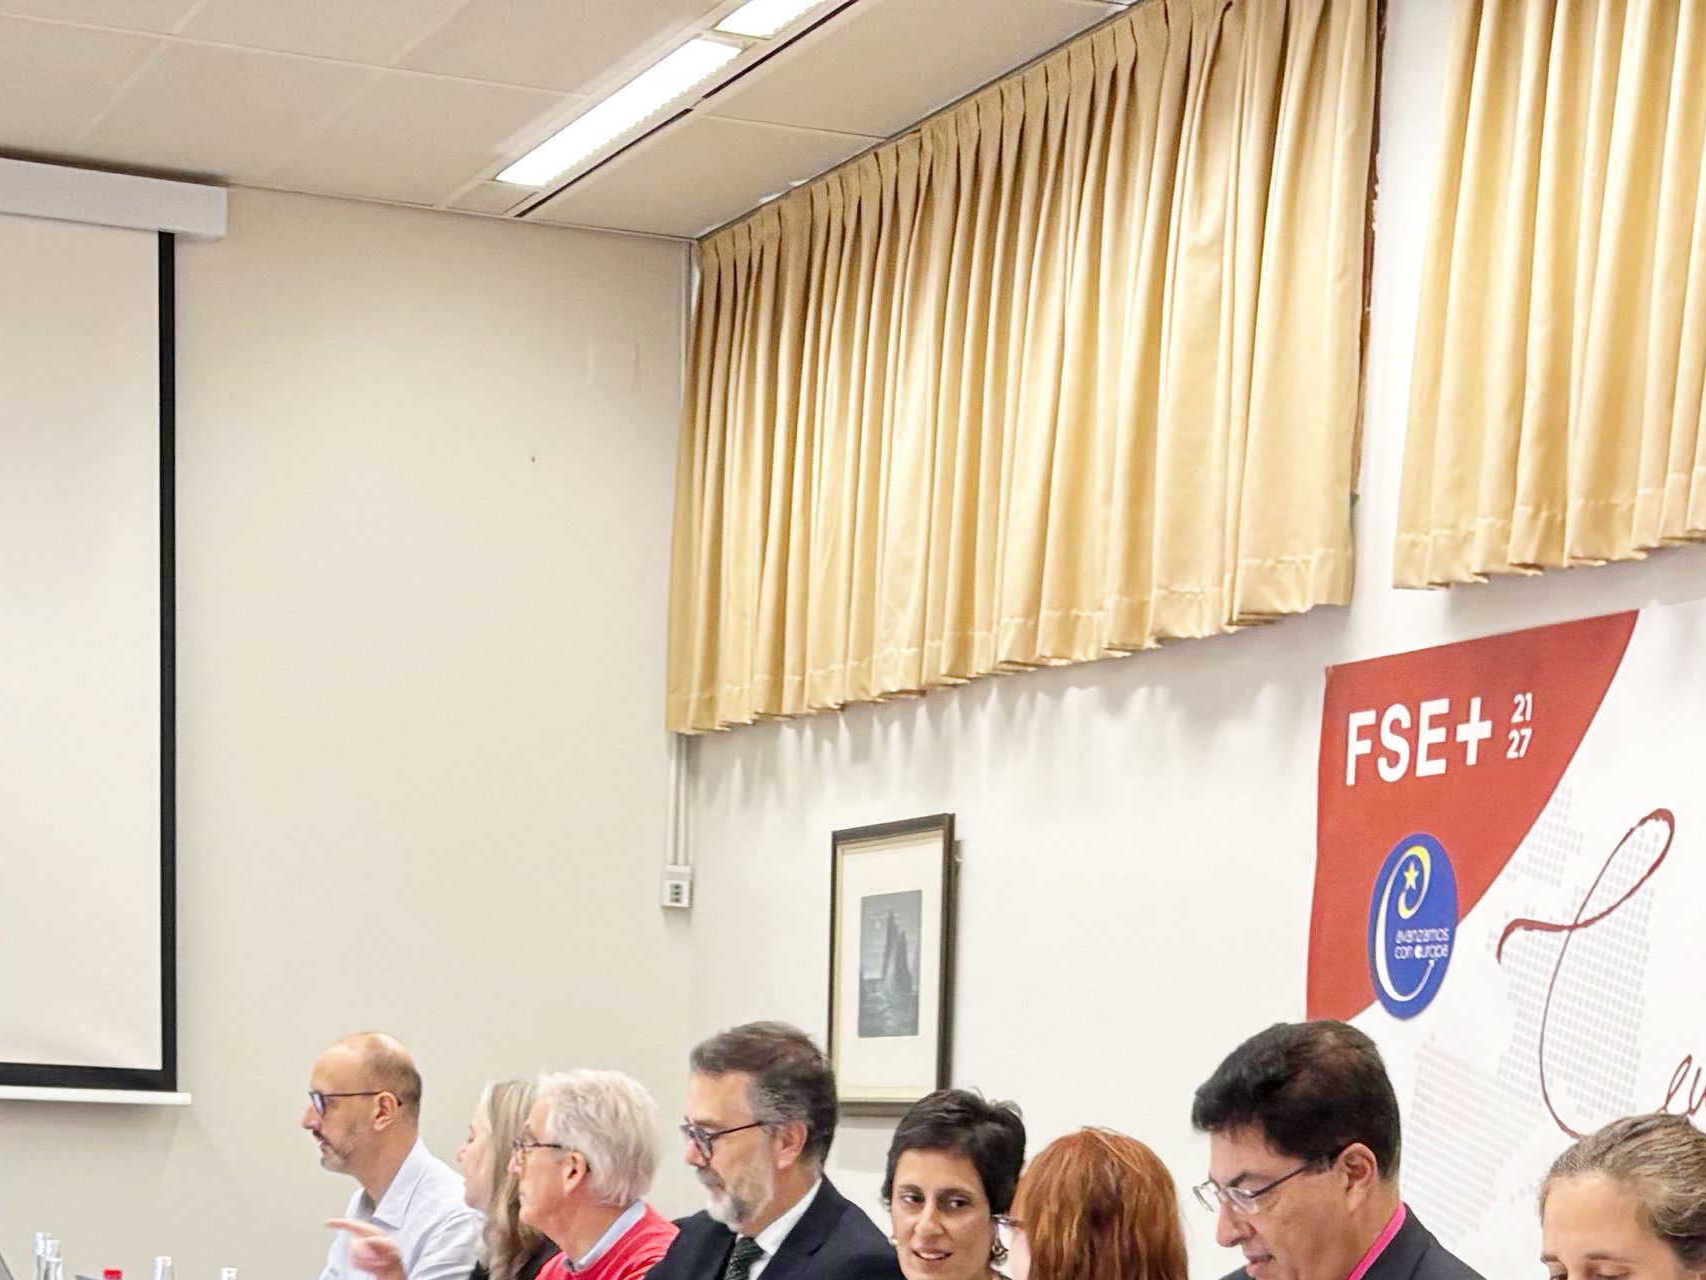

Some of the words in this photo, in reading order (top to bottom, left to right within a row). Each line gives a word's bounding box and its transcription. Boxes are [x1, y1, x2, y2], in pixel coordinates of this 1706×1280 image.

[1511, 692, 1533, 723] 21
[1346, 697, 1493, 786] FSE+
[1506, 728, 1533, 759] 27
